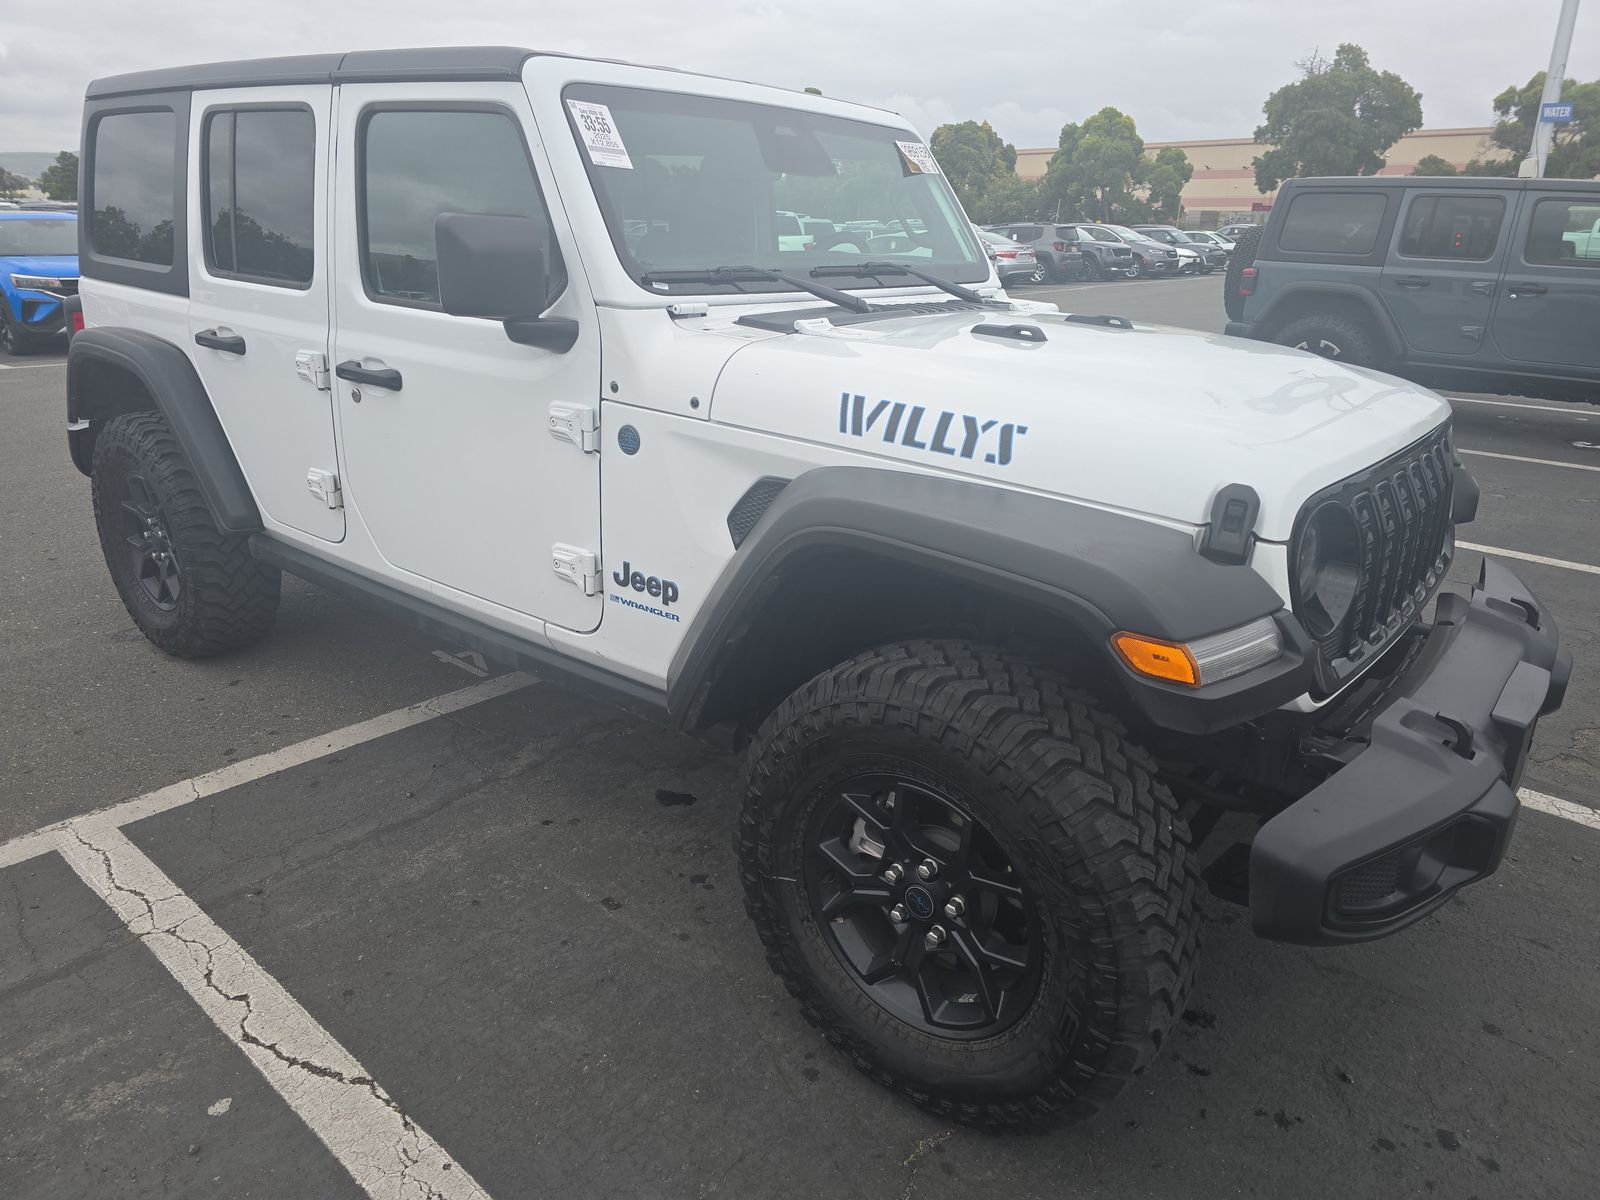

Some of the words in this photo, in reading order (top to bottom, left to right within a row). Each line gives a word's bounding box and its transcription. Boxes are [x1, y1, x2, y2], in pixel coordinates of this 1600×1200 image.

[1544, 107, 1571, 117] WATER
[581, 114, 611, 133] 33:55
[594, 132, 611, 140] 2025
[839, 391, 1029, 466] WILLYS
[612, 560, 679, 607] Jeep
[619, 597, 680, 622] WRANGLER
